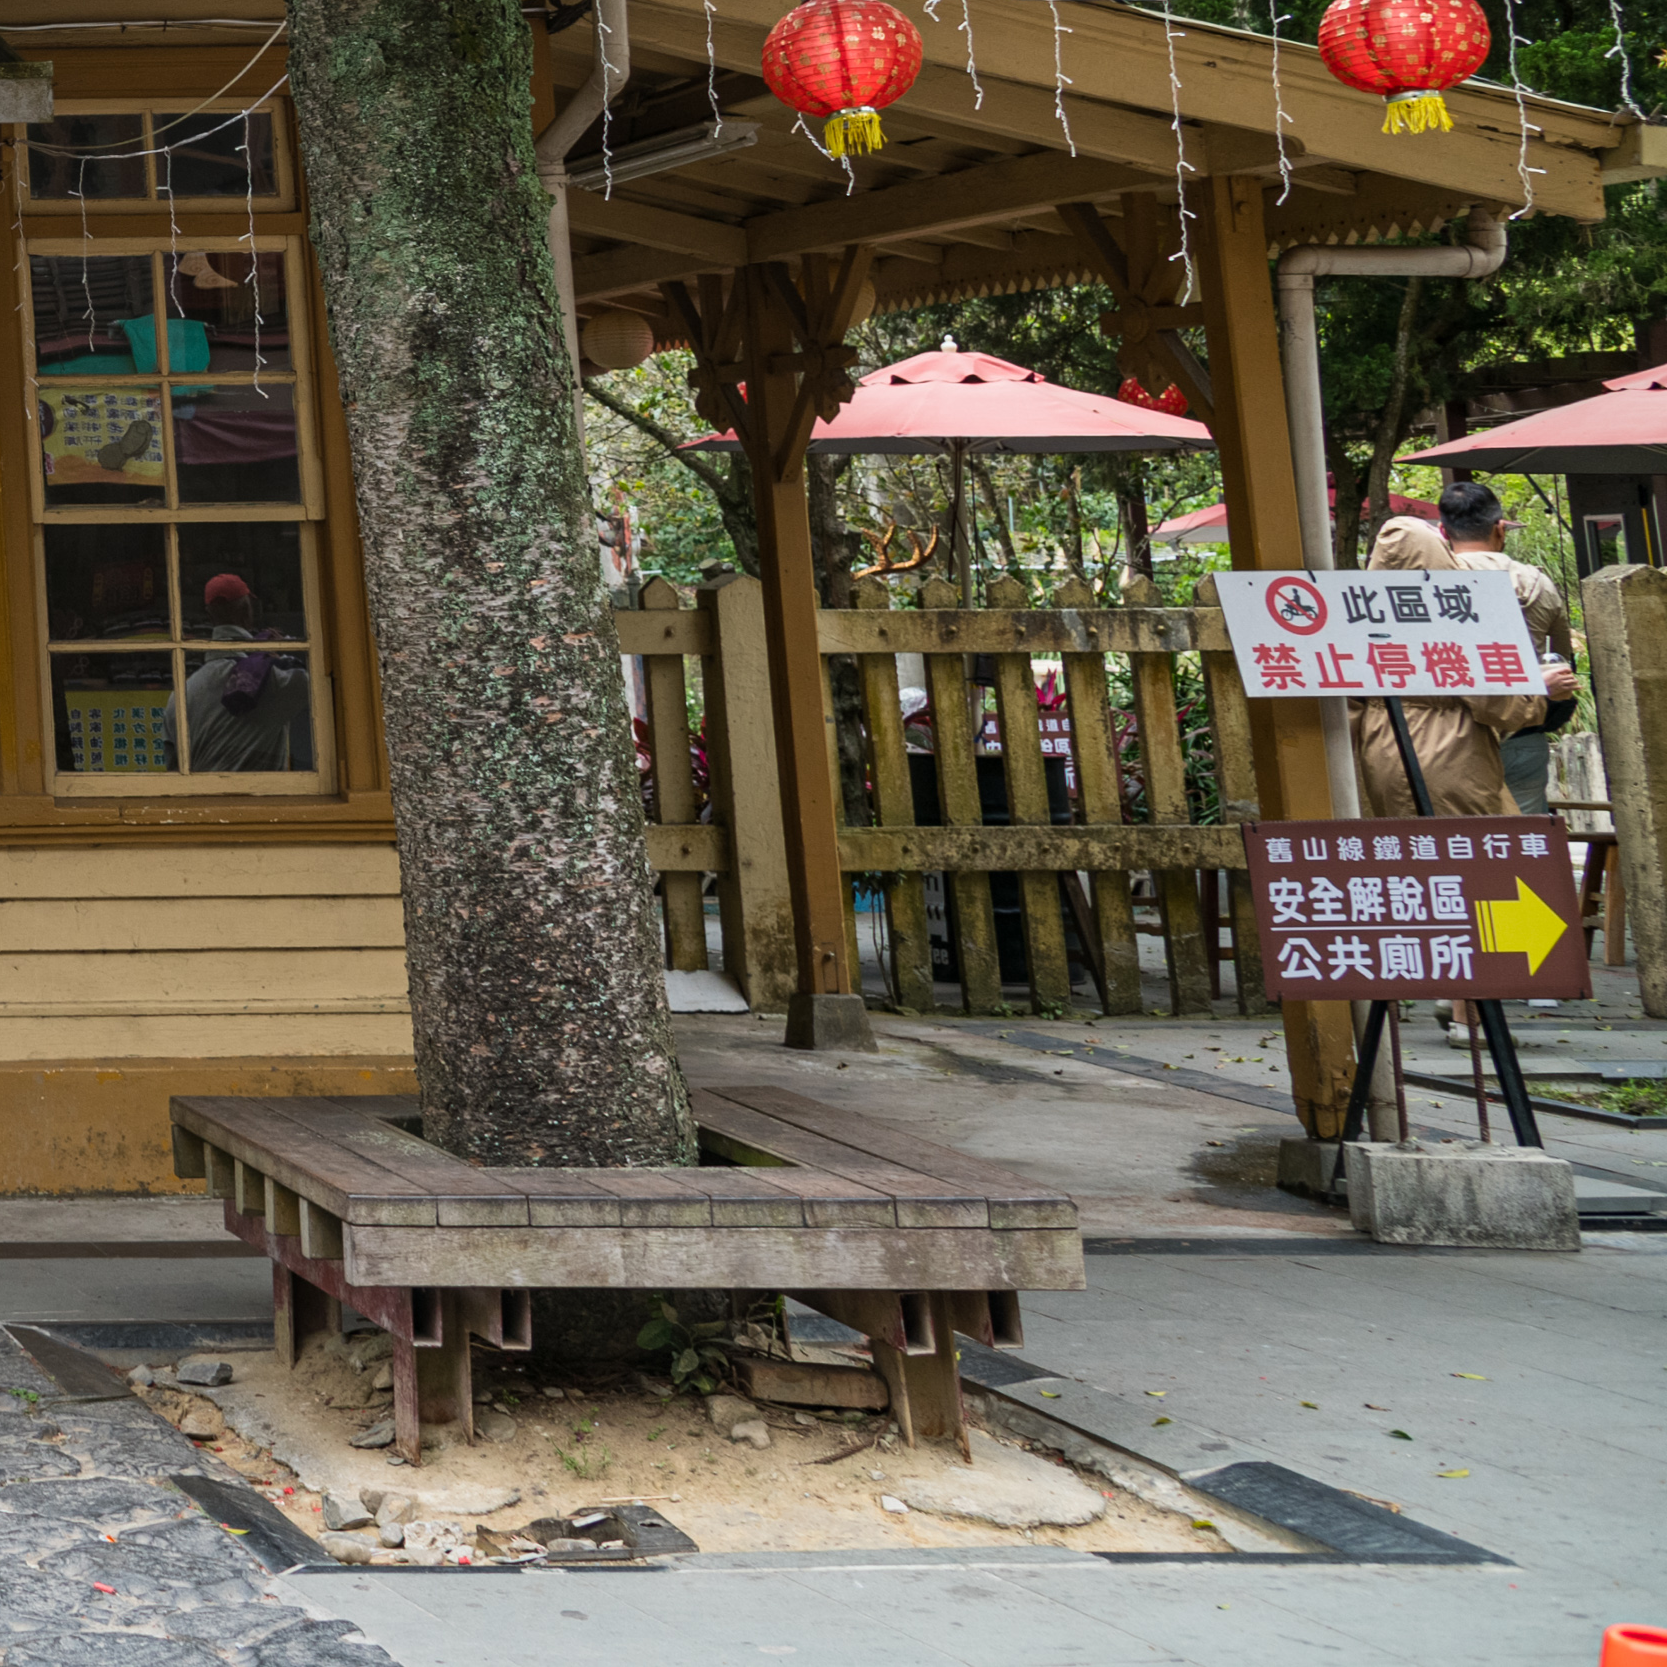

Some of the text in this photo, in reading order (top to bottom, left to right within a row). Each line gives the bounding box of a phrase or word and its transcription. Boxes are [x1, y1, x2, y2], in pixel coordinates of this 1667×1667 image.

[1341, 584, 1480, 625] 此區域
[1252, 641, 1530, 692] 禁止停機車
[1265, 832, 1550, 864] 舊山線鐵道自行車
[1268, 874, 1470, 924] 安全解說區
[1277, 934, 1474, 981] 公共廁所
